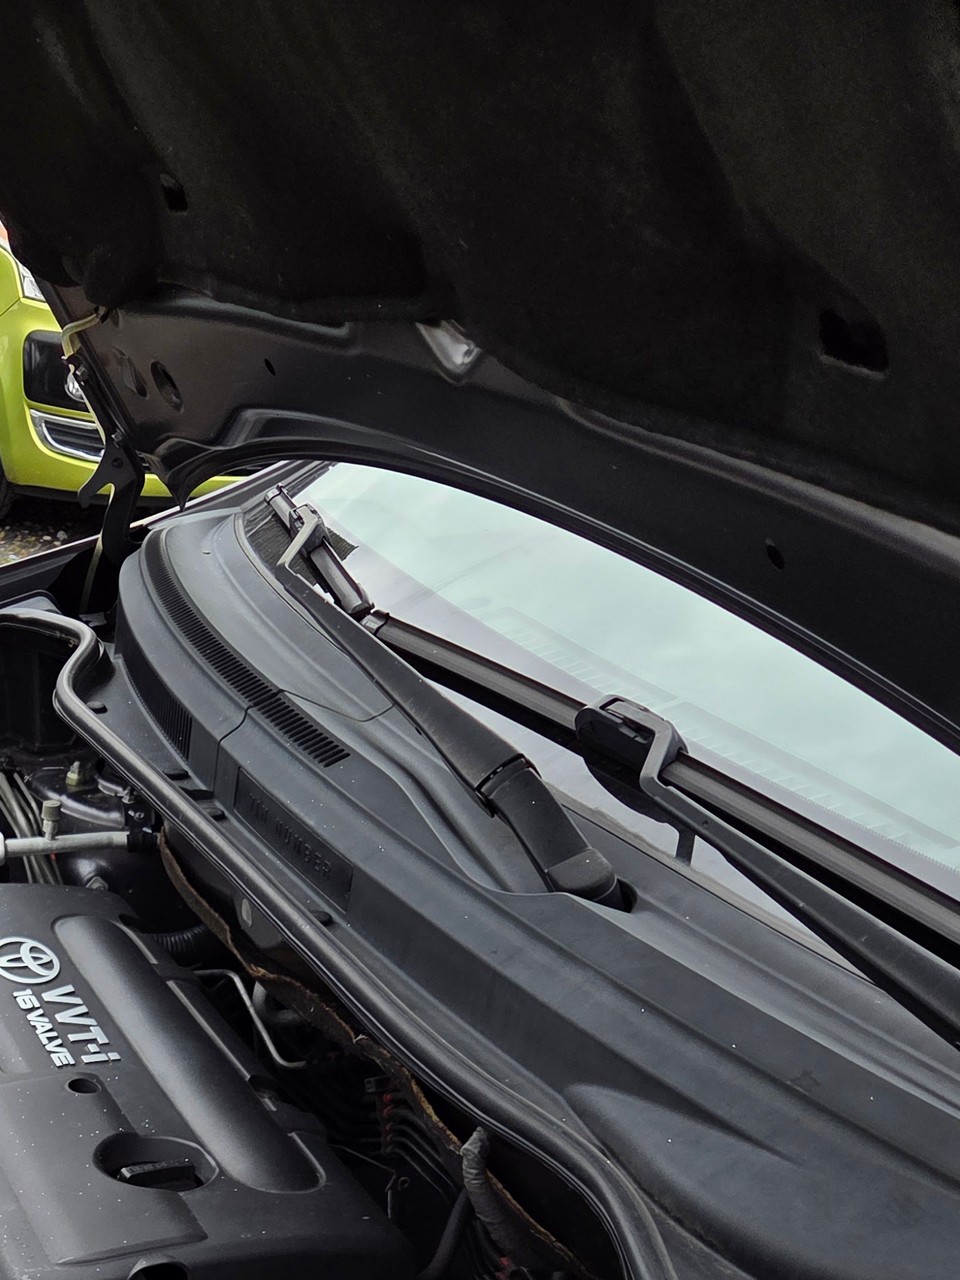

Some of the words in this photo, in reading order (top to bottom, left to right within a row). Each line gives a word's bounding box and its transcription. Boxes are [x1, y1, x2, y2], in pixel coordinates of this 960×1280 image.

[12, 988, 41, 1010] 16
[41, 984, 121, 1064] VVT-i
[26, 1008, 76, 1067] VALVE
